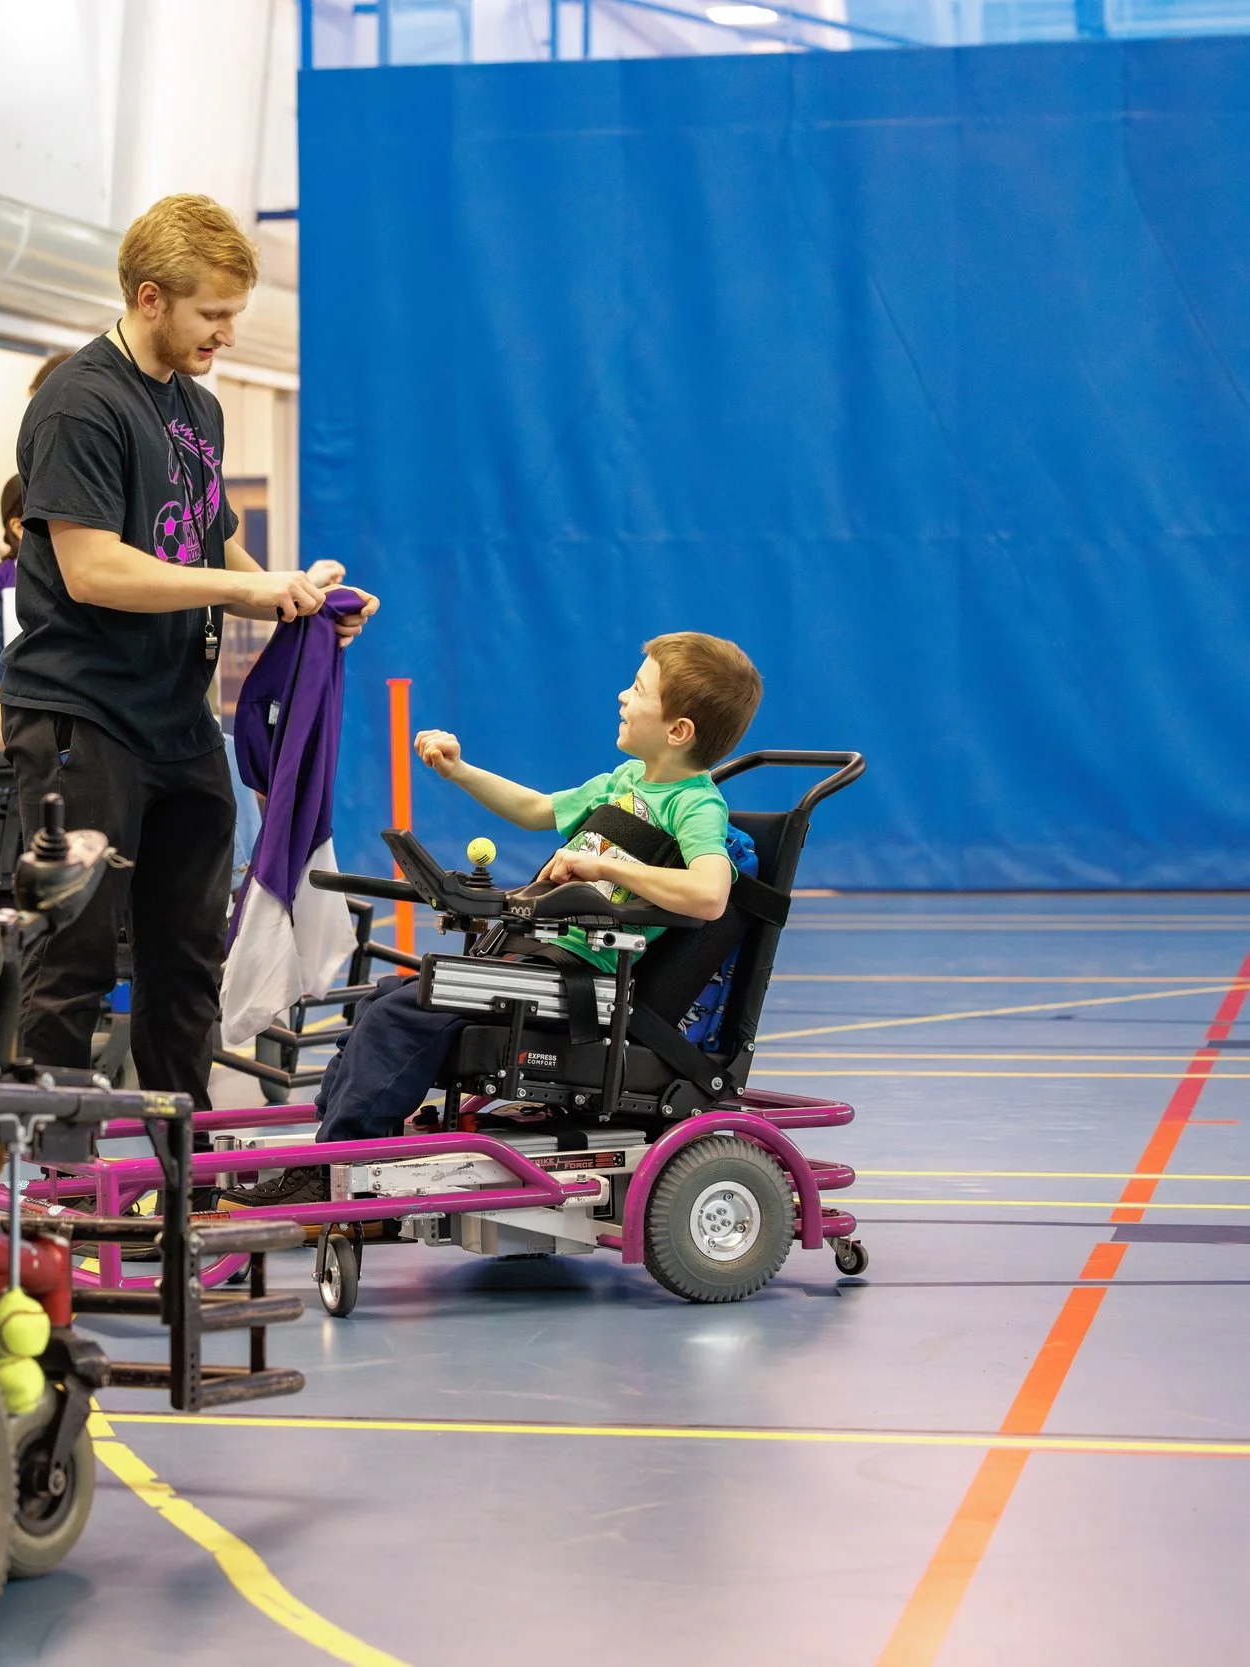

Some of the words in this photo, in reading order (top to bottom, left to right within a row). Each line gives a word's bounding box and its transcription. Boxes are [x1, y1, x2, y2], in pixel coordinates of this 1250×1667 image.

[527, 1052, 557, 1061] EXPRESS
[527, 1059, 557, 1067] COMFORT
[564, 1161, 594, 1170] FORCE
